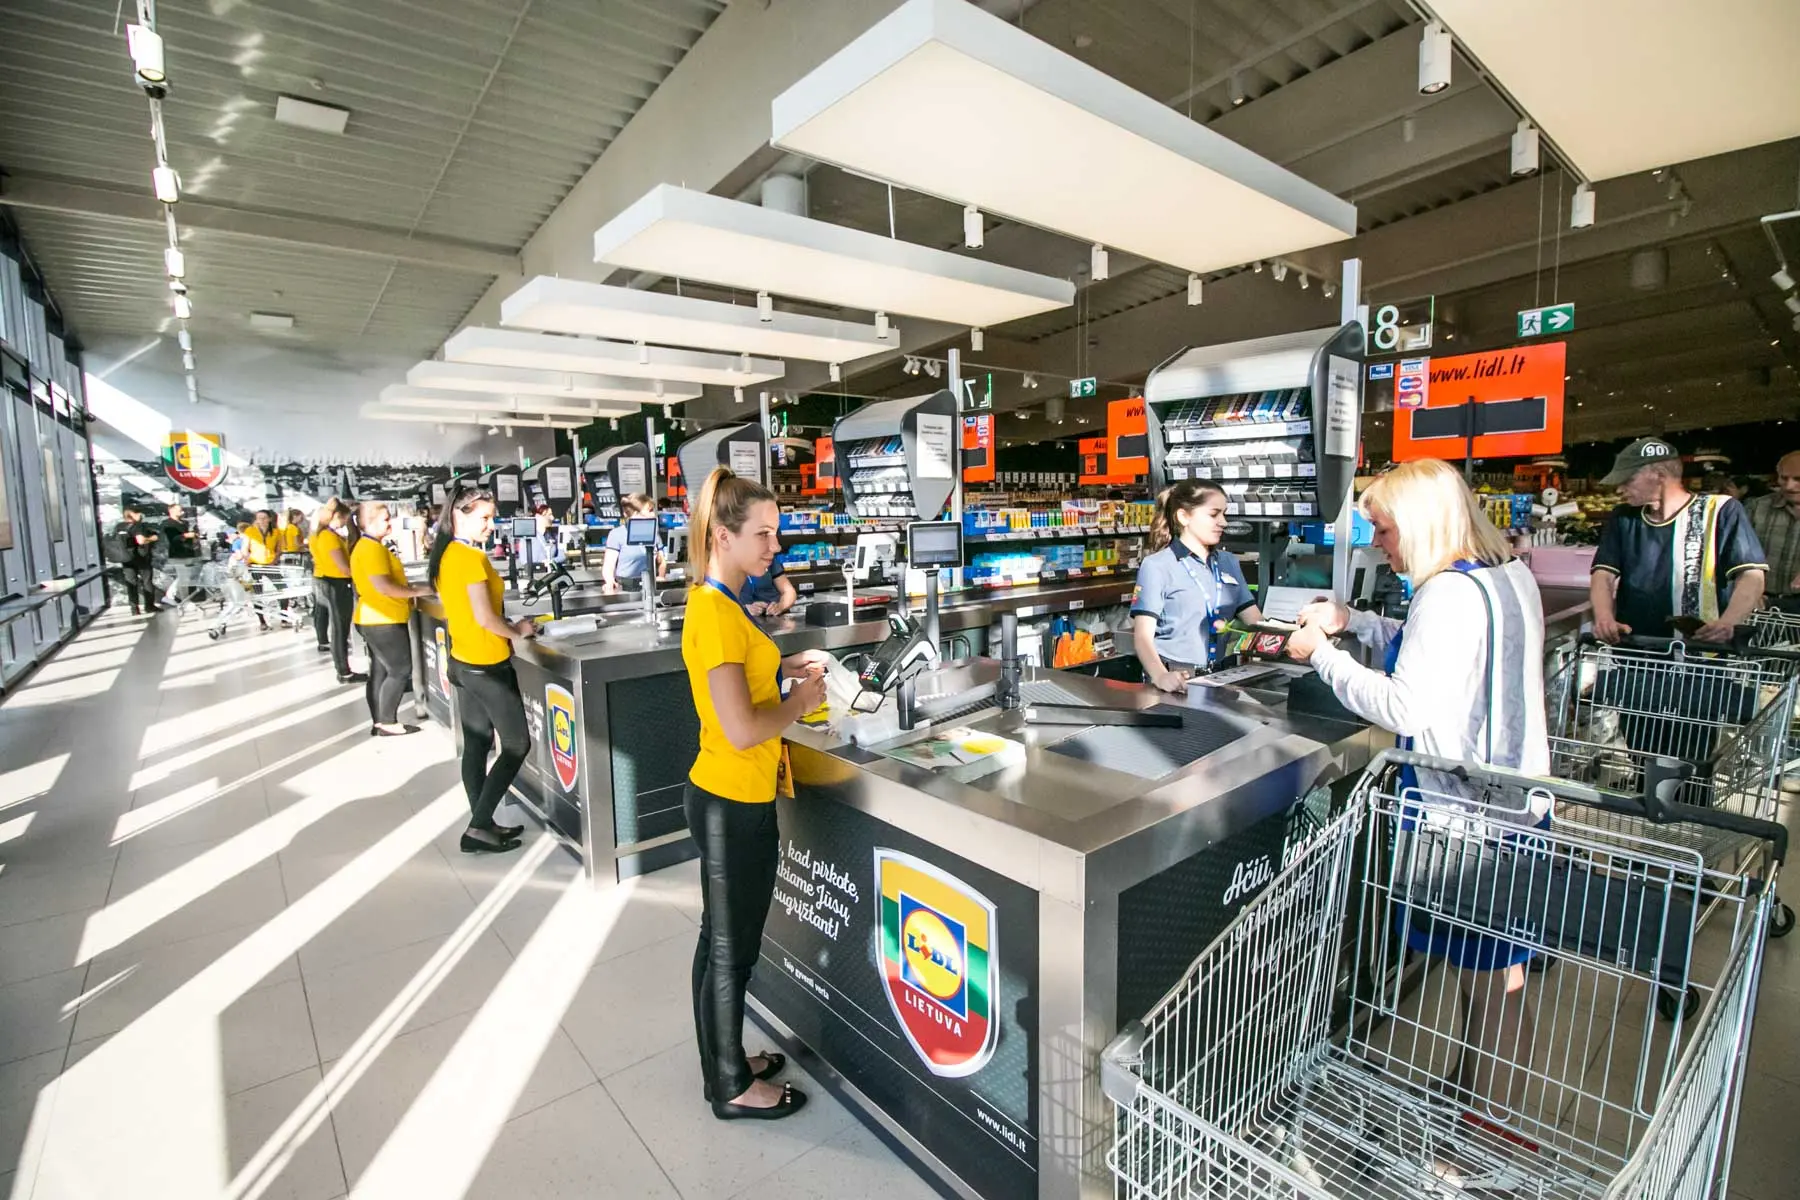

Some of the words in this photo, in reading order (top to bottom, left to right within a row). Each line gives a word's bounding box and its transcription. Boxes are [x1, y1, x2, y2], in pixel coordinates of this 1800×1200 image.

[1374, 304, 1400, 350] 8
[1429, 354, 1526, 384] www.lidl.lt
[788, 840, 811, 869] kad
[811, 860, 859, 903] pirkote,
[773, 886, 839, 941] sugrįžtant!
[815, 884, 850, 927] Jūsų
[905, 989, 962, 1038] LIETUVA
[977, 1108, 1026, 1153] www.lidl.lt
